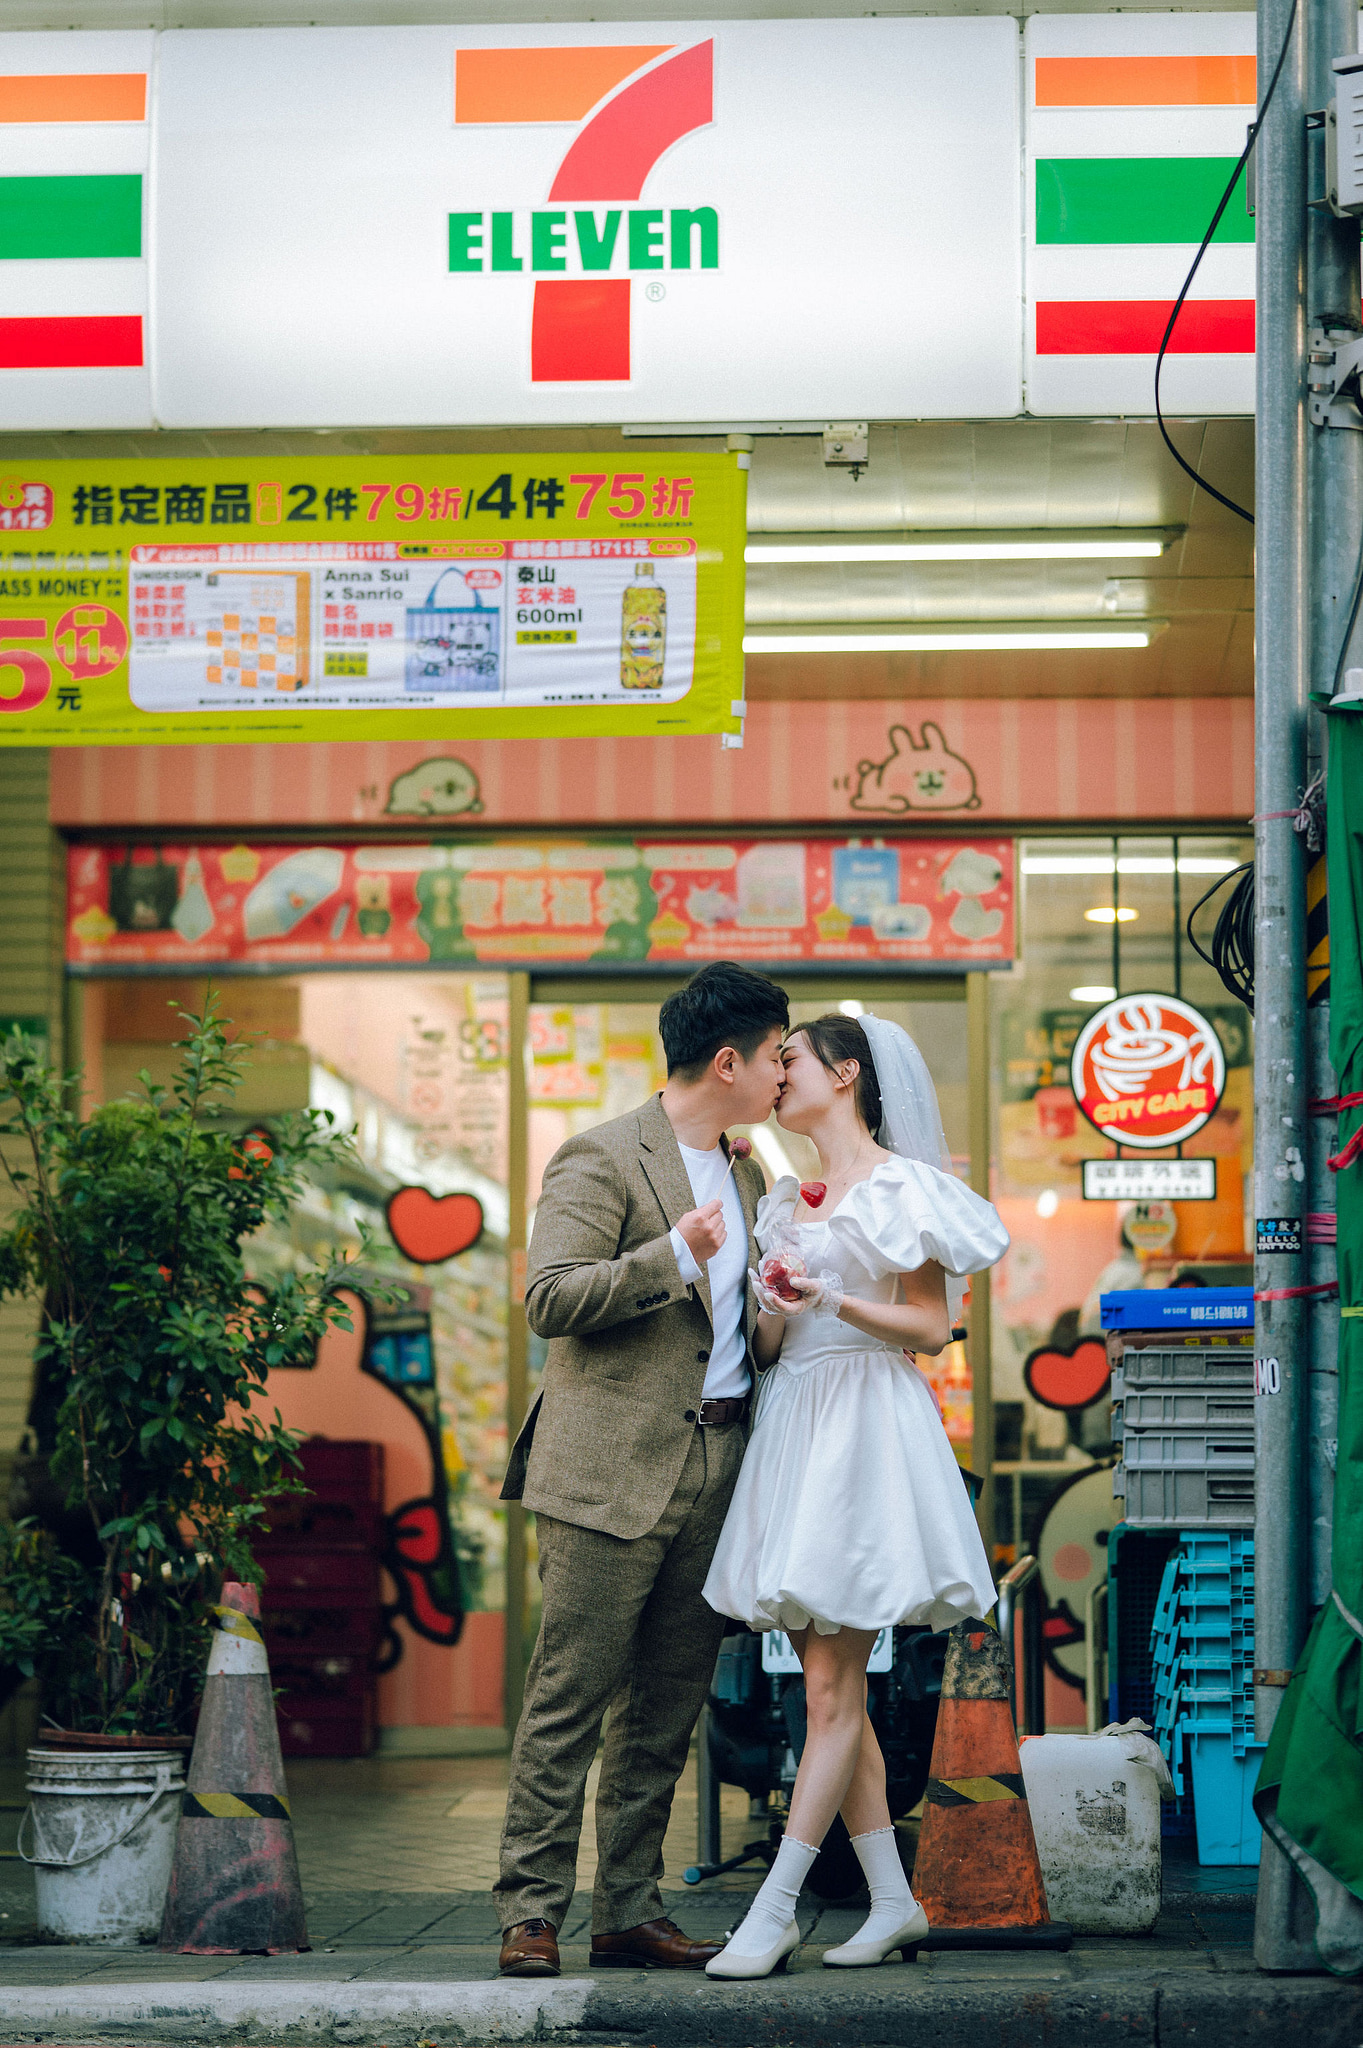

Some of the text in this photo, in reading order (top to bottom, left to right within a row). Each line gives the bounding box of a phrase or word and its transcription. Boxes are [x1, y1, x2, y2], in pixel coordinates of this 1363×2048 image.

[455, 37, 714, 382] 7
[72, 483, 251, 526] 指定商品
[324, 568, 410, 582] Anna Sui
[517, 565, 556, 584] 泰山
[39, 578, 101, 598] MONEY
[325, 587, 404, 600] x Sanrio
[516, 586, 576, 605] 玄米油
[516, 608, 583, 624] 600ml
[1092, 1087, 1209, 1125] CITY CAFE
[1256, 1242, 1301, 1251] TATTOO
[1259, 1235, 1297, 1243] HELLO
